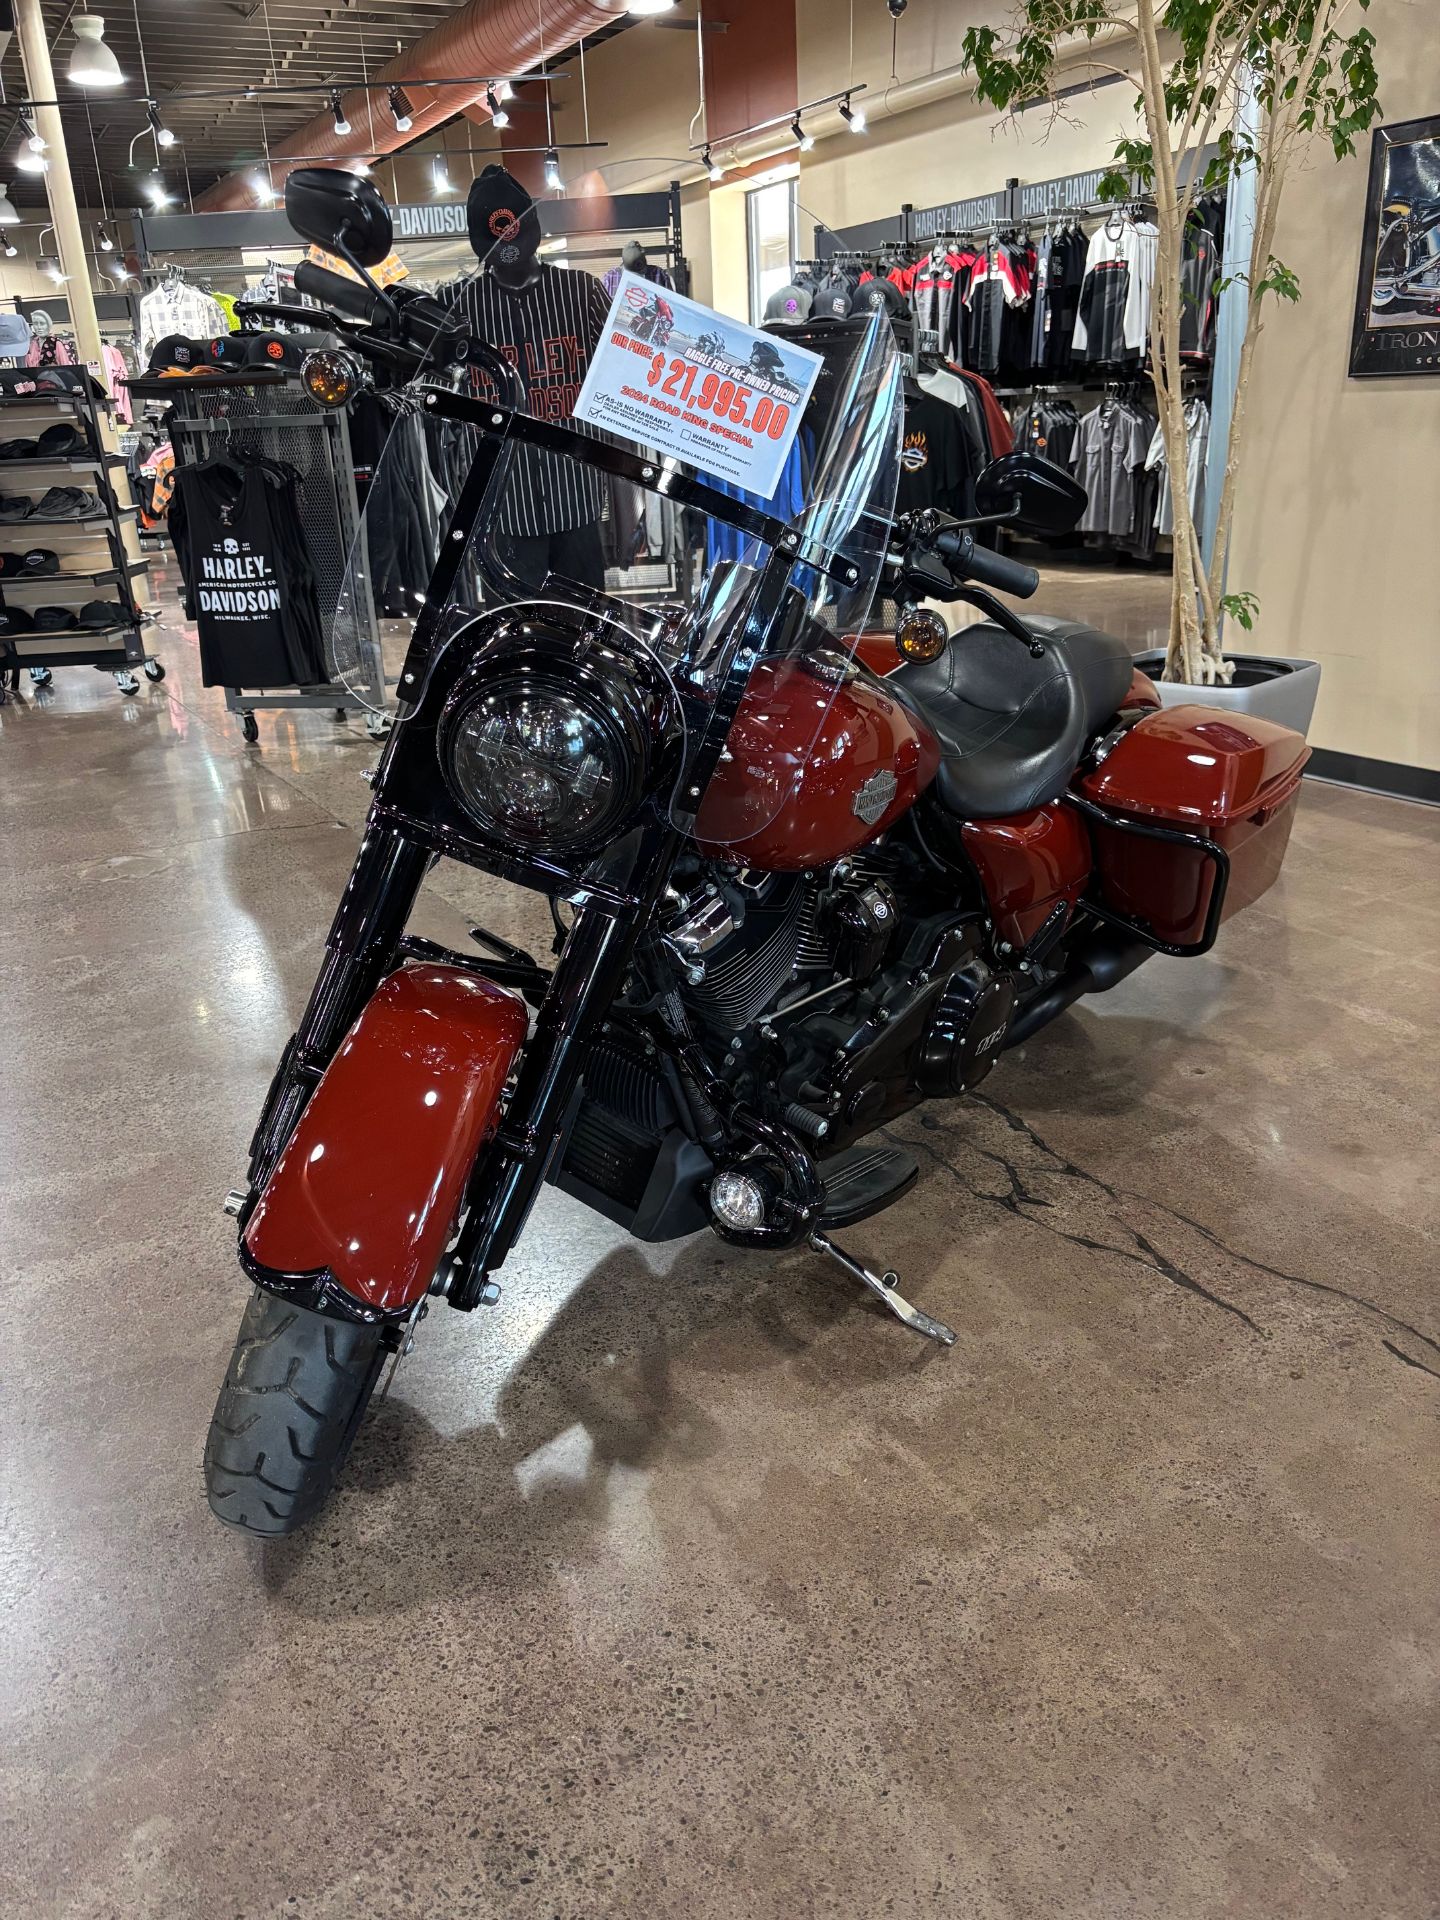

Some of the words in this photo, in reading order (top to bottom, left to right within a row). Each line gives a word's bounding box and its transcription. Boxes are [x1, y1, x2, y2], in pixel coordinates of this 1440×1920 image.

[1022, 172, 1104, 216] HARLEY-DAVID
[915, 196, 997, 238] HARLEY-DAVIDSON
[611, 332, 629, 349] OUR
[628, 339, 654, 360] PRICE:
[684, 347, 713, 367] HAGGLE
[711, 359, 729, 375] FREE
[729, 366, 772, 392] PRE-OWNED
[769, 383, 800, 404] PRICING
[605, 397, 623, 408] AS-IS
[624, 404, 634, 412] NO
[634, 409, 672, 427] WARRANTY
[621, 385, 649, 403] 2024
[649, 396, 681, 417] ROAD
[681, 410, 708, 430] KING
[709, 423, 754, 449] SPECIAL
[607, 417, 632, 430] EXTENDED
[631, 427, 651, 439] SERVICE
[651, 435, 676, 449] CONTRACT
[692, 433, 729, 452] WARRANTY
[202, 555, 272, 580] HARLEY-
[199, 588, 281, 613] DAVIDSON
